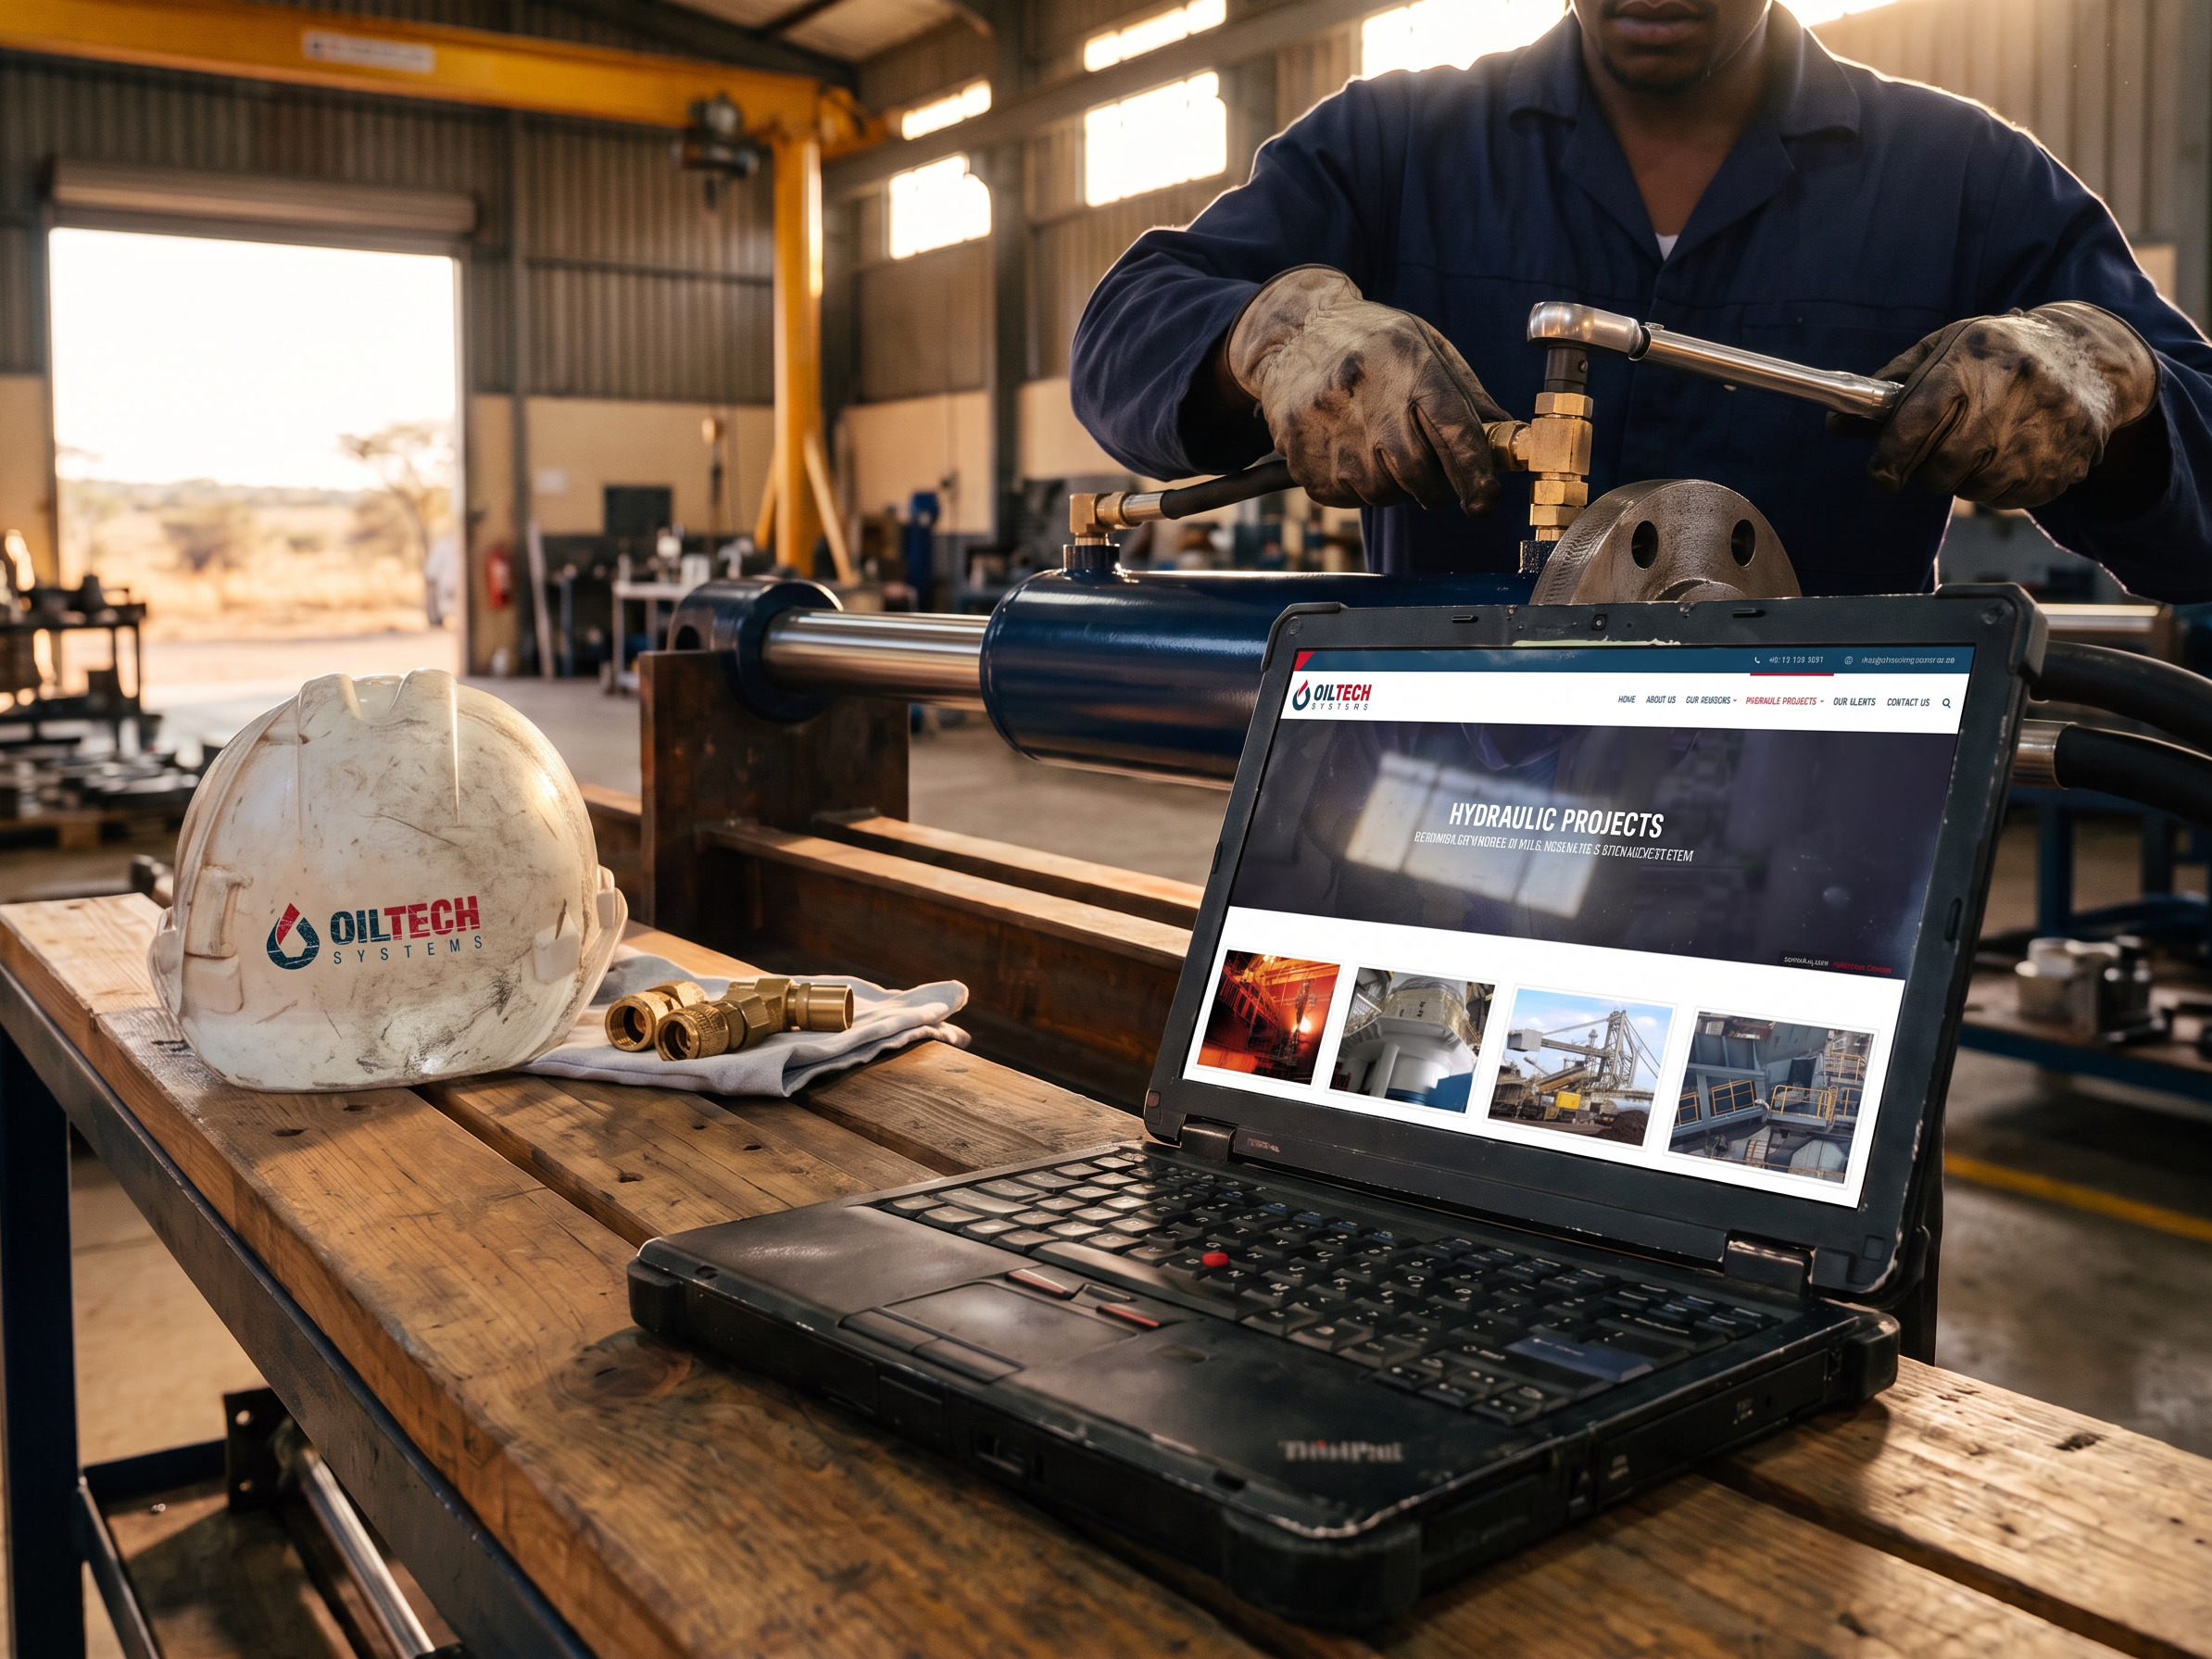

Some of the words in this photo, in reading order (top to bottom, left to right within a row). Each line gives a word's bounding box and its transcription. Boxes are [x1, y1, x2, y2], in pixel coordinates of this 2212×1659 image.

[1313, 684, 1373, 701] OILTECH
[1617, 695, 1636, 704] HOME
[1645, 695, 1666, 704] ABOUT
[1667, 696, 1677, 704] US
[1887, 698, 1918, 707] CONTACT
[1920, 698, 1930, 707] US
[1449, 802, 1557, 832] HYDRAULIC
[1560, 808, 1665, 839] PROJECTS
[330, 895, 481, 946] OILTECH
[333, 935, 483, 965] SYSTEMS
